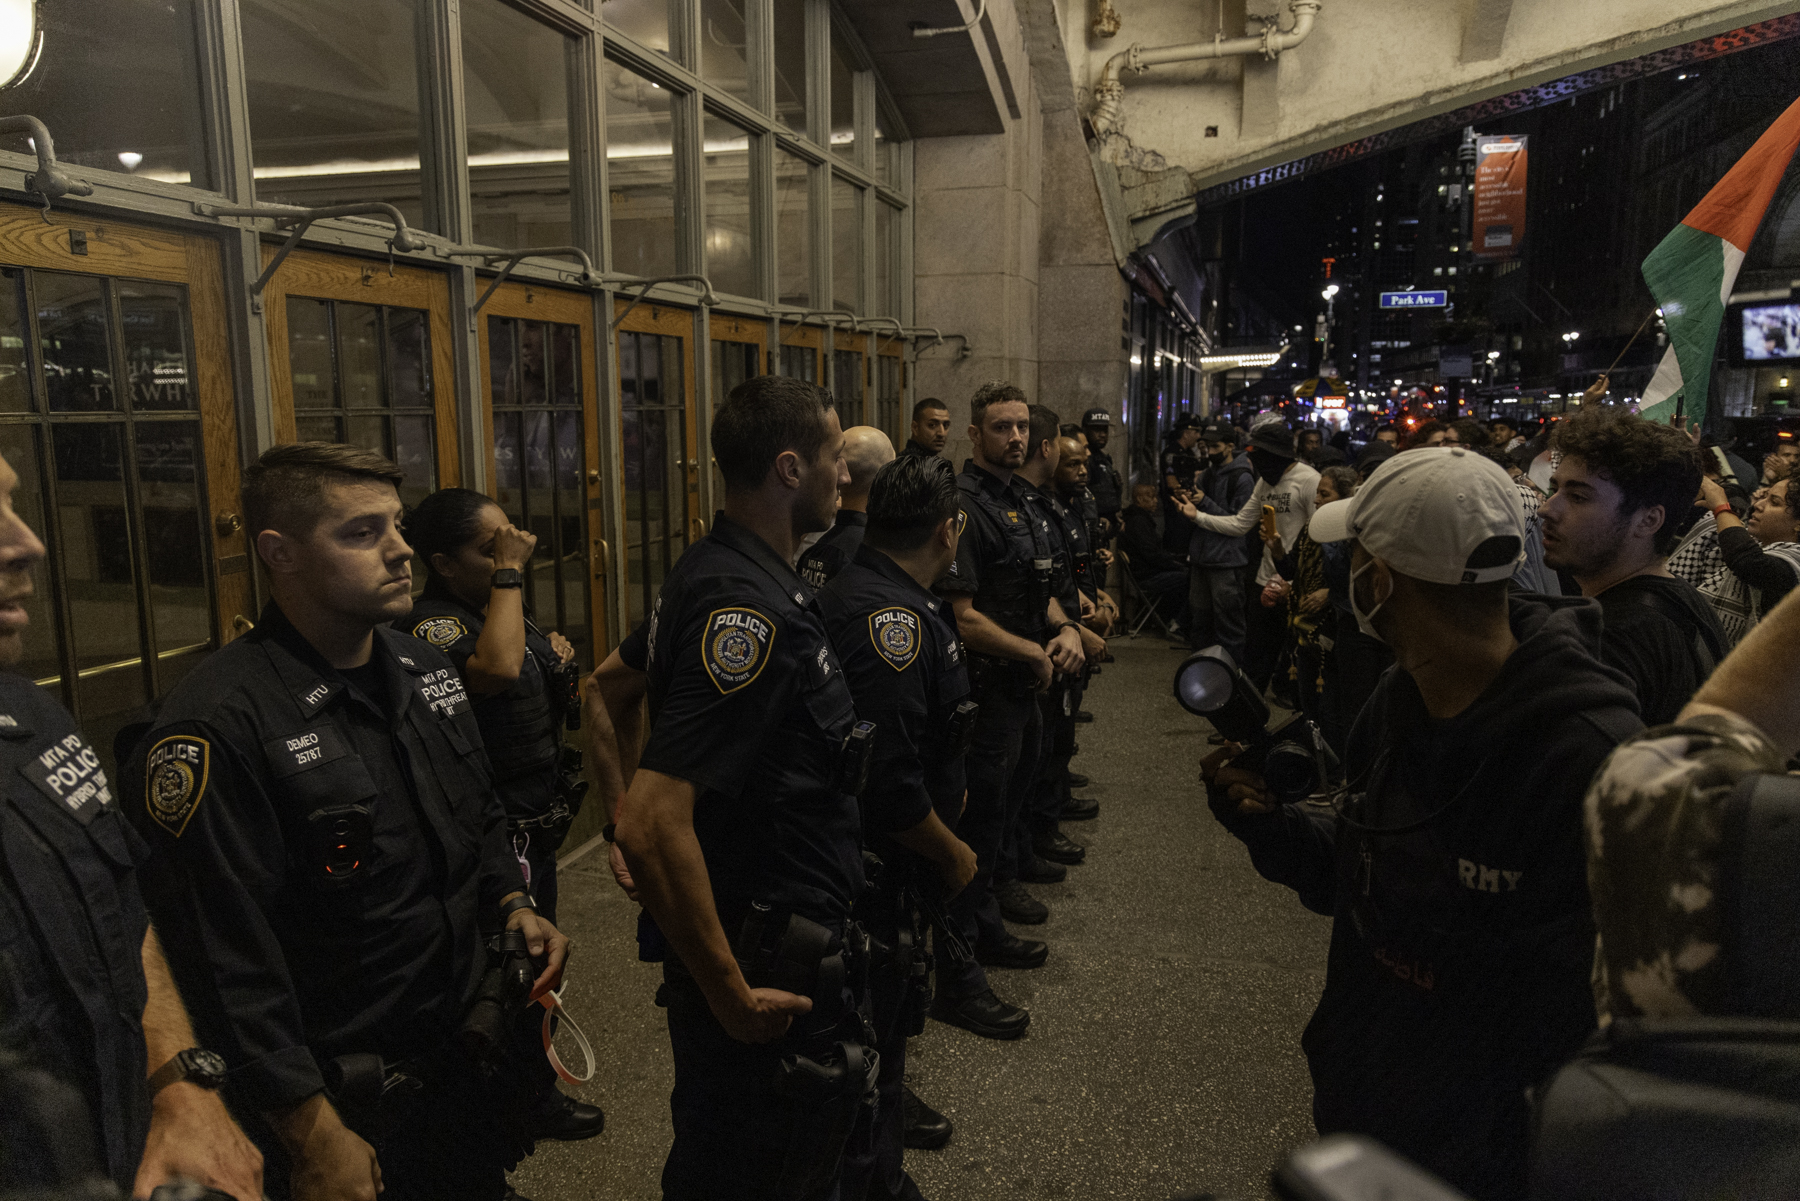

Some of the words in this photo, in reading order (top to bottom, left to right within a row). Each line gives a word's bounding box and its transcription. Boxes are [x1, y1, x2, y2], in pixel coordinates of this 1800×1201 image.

[1391, 295, 1414, 305] Park
[1415, 295, 1435, 305] Ave
[802, 568, 827, 588] POLICE
[713, 613, 769, 644] POLICE
[875, 611, 916, 629] POLICE
[421, 672, 437, 684] MTA
[436, 668, 449, 681] PD
[710, 662, 721, 675] NEW
[720, 671, 734, 682] YORK
[734, 671, 751, 682] STATE
[306, 684, 329, 704] HTU
[421, 677, 464, 701] POLICE
[39, 746, 70, 770] MTA
[61, 734, 82, 752] PD
[286, 732, 319, 752] DEMEO
[150, 743, 200, 775] POLICE
[295, 746, 322, 765] 25787
